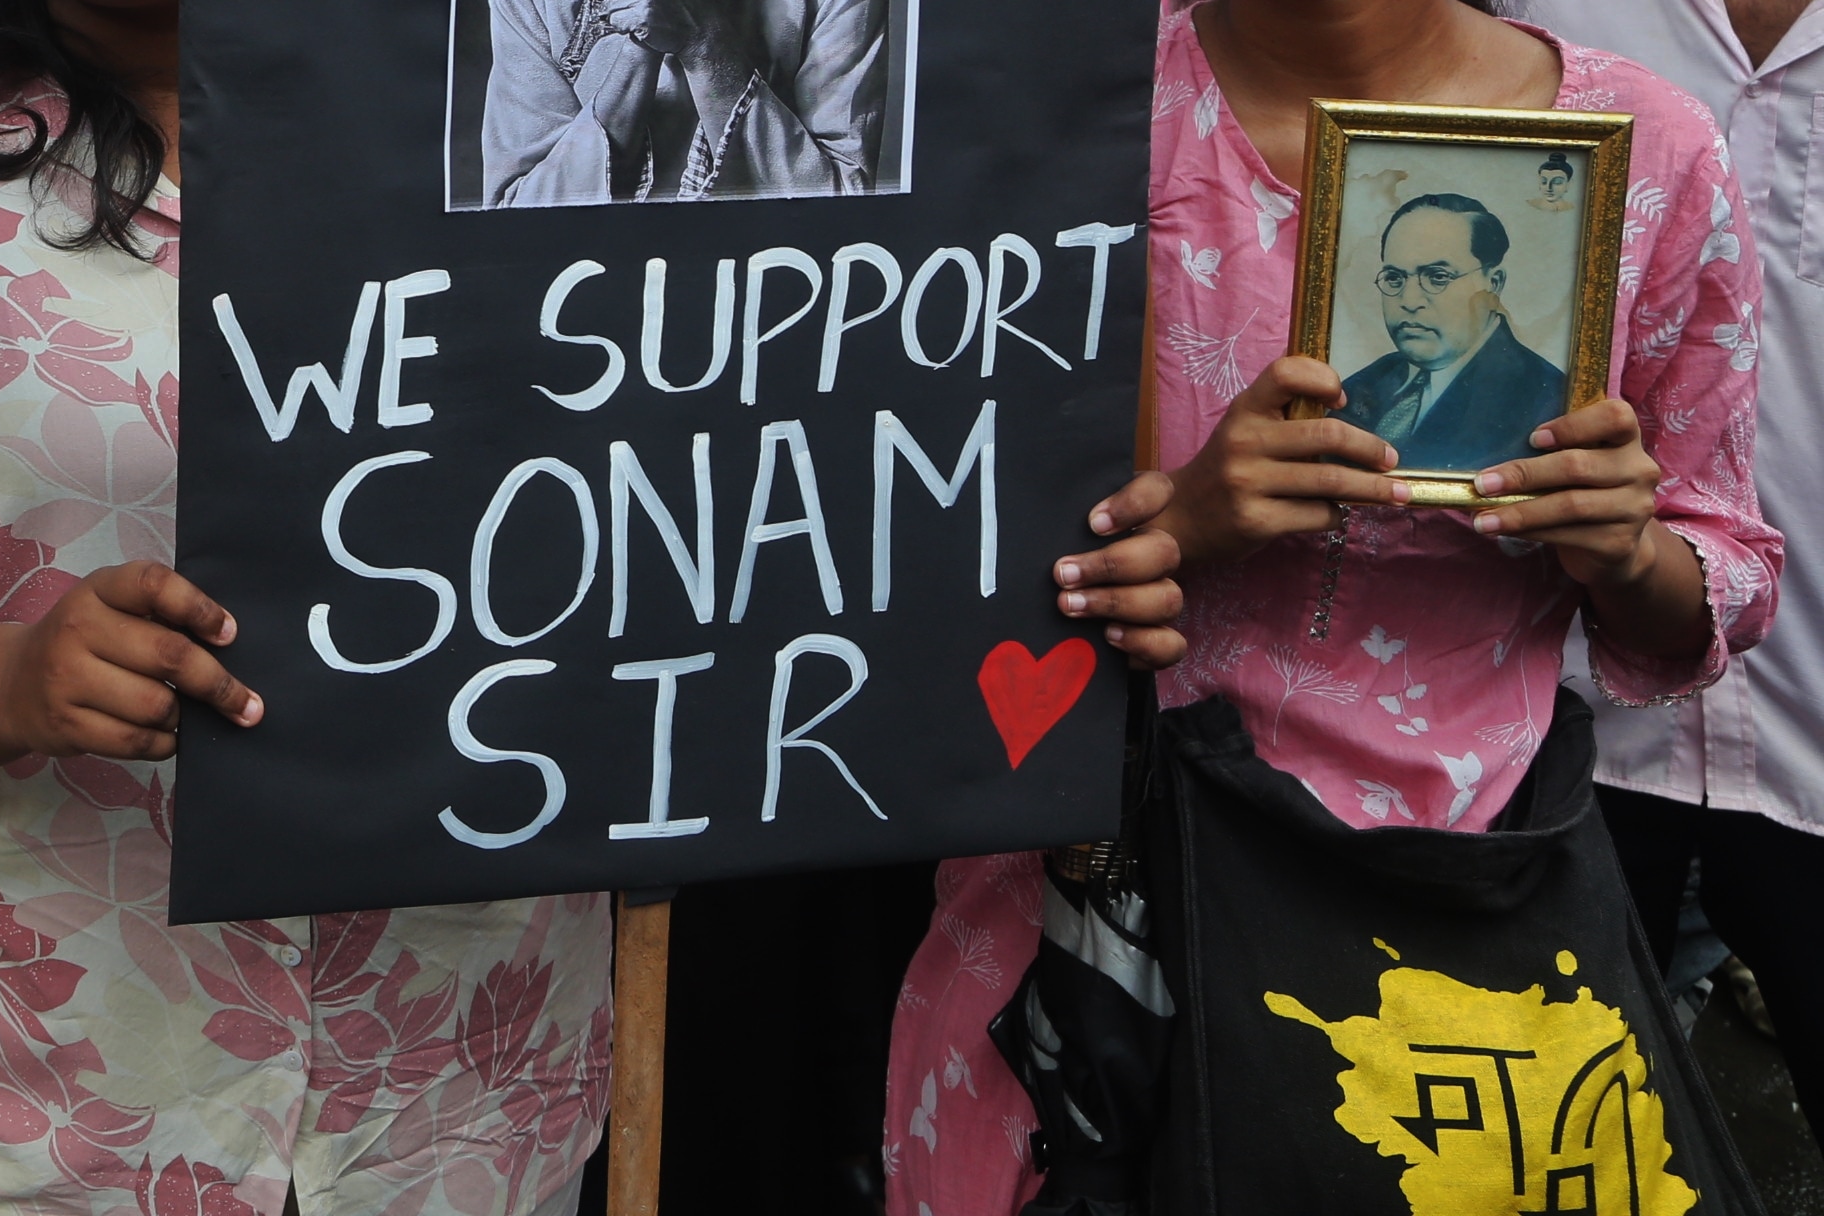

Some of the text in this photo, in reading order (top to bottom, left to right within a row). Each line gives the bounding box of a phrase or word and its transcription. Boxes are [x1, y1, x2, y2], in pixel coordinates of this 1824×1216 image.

[212, 221, 1136, 442] WE SUPPORT
[307, 399, 998, 673] SONAM
[438, 632, 888, 849] SIR
